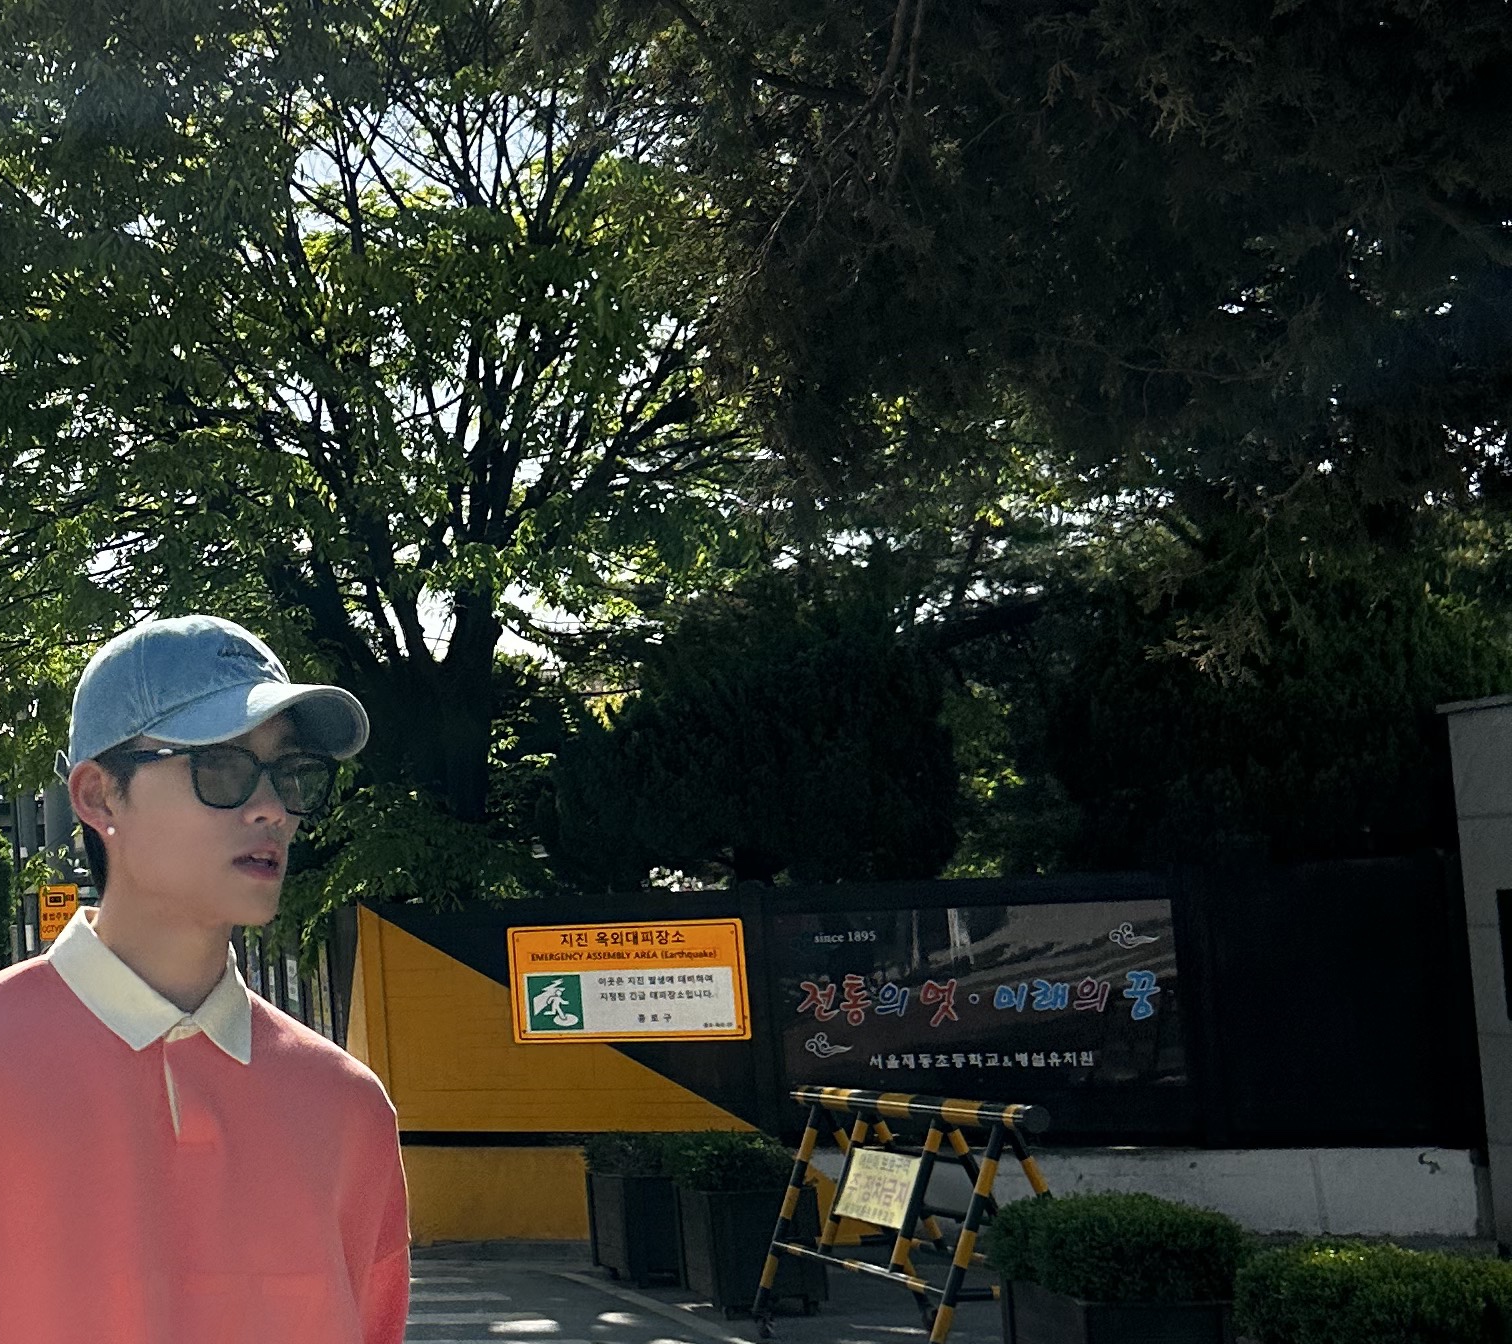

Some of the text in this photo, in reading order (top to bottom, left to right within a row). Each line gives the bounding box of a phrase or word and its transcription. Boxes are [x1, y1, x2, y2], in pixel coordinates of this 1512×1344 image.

[560, 930, 686, 948] 지진 옥외대피장소
[814, 930, 877, 944] since 1895
[530, 948, 718, 962] EMERGENCY ASSEMBLY AREA (Earthquake)
[597, 976, 625, 987] 이곳은
[627, 975, 645, 986] 지진
[677, 974, 714, 985] 대비하여
[629, 991, 646, 1001] 긴급
[796, 973, 910, 1026] 전통의
[993, 976, 1110, 1012] 미래의
